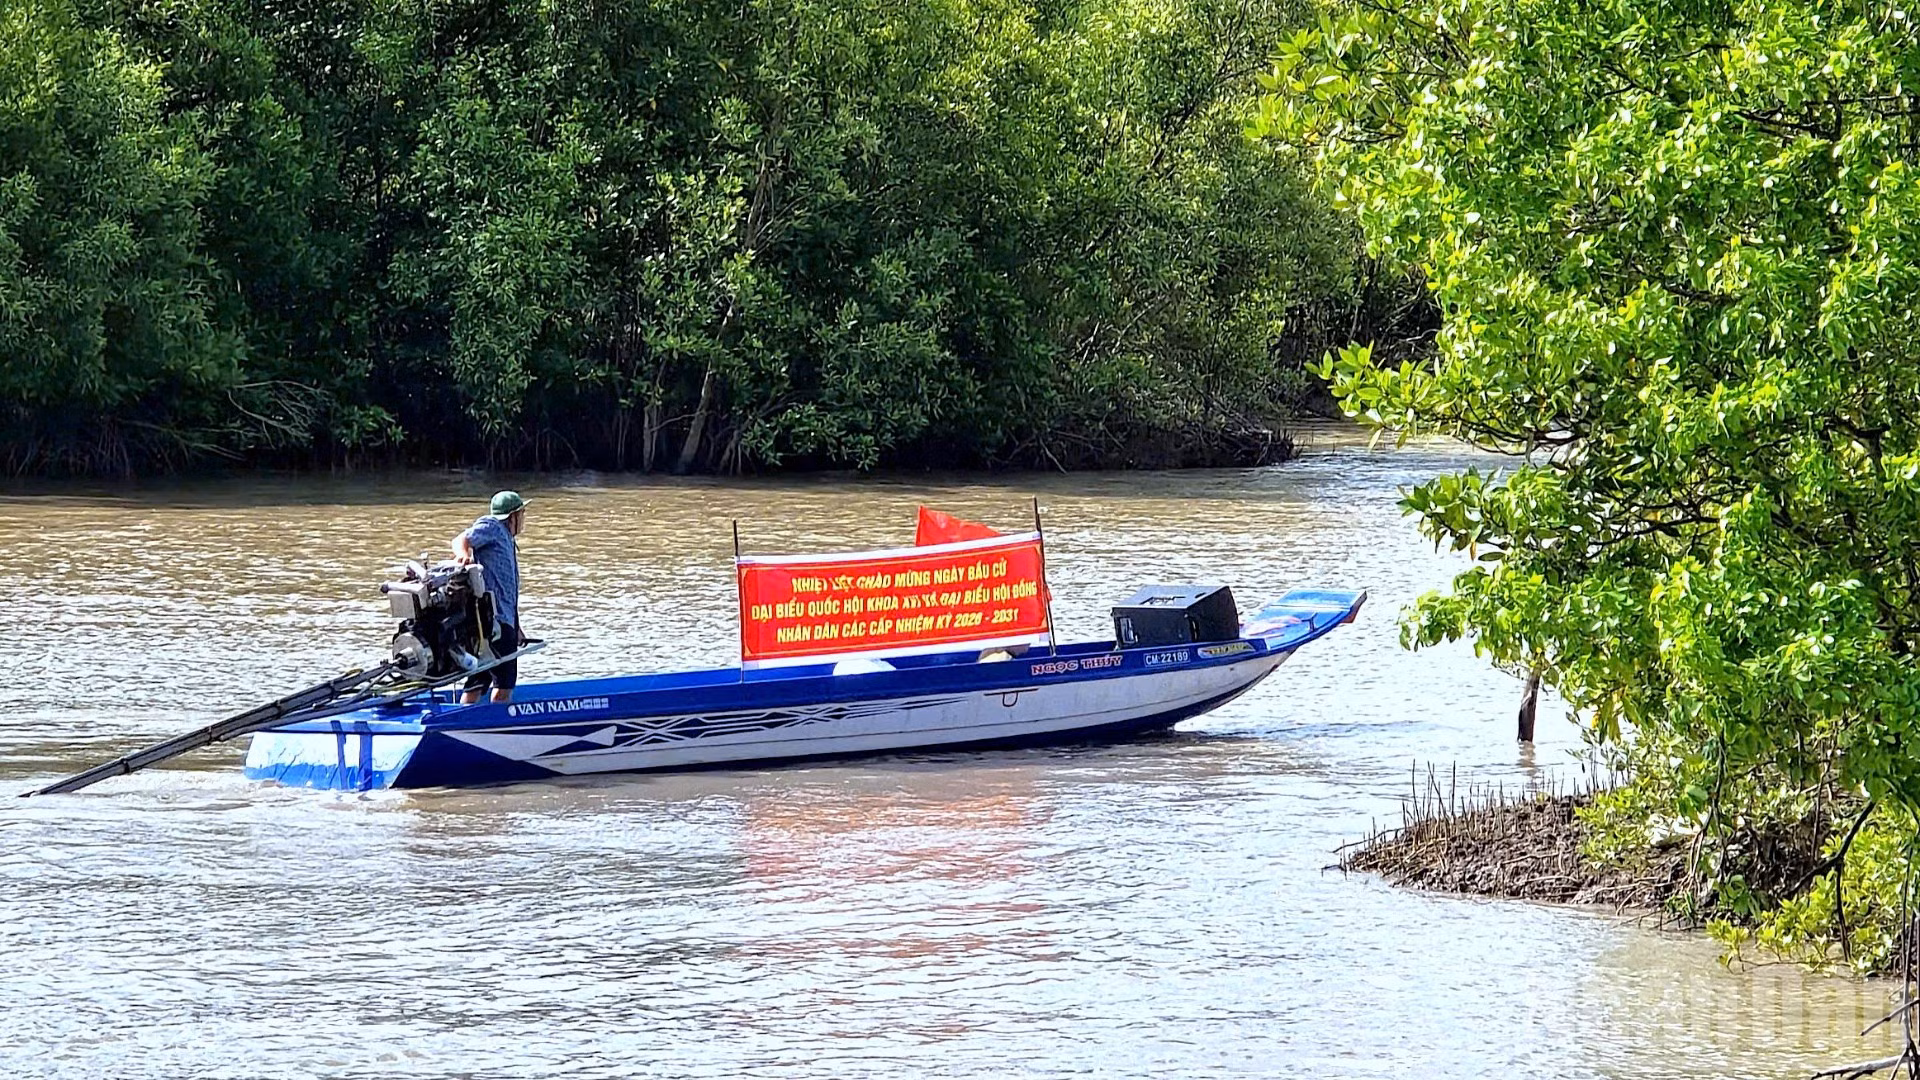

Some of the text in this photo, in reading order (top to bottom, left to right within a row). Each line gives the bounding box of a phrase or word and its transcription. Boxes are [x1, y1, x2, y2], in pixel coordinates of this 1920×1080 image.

[856, 572, 891, 588] CHÀO
[895, 569, 930, 587] MỪNG
[934, 564, 965, 584] NGÀY
[968, 560, 989, 581] BẦU
[992, 557, 1007, 578] CỬ
[751, 603, 772, 623] ĐẠI
[775, 597, 804, 618] BIỂU
[808, 595, 840, 617] QUỐC
[843, 596, 863, 616] HỘI
[867, 596, 899, 612] KHOA
[963, 584, 990, 605] BIỂU
[993, 583, 1010, 604] HỘI
[1012, 578, 1037, 597] ĐỒNG
[777, 624, 811, 643] NHÂN
[813, 622, 839, 640] DÂN
[842, 620, 867, 638] CÁC
[869, 615, 893, 634] CẤP
[896, 613, 934, 635] NHIỆM
[936, 612, 953, 626] KỲ
[992, 608, 1019, 624] 2031
[1031, 660, 1078, 676] NGỌC
